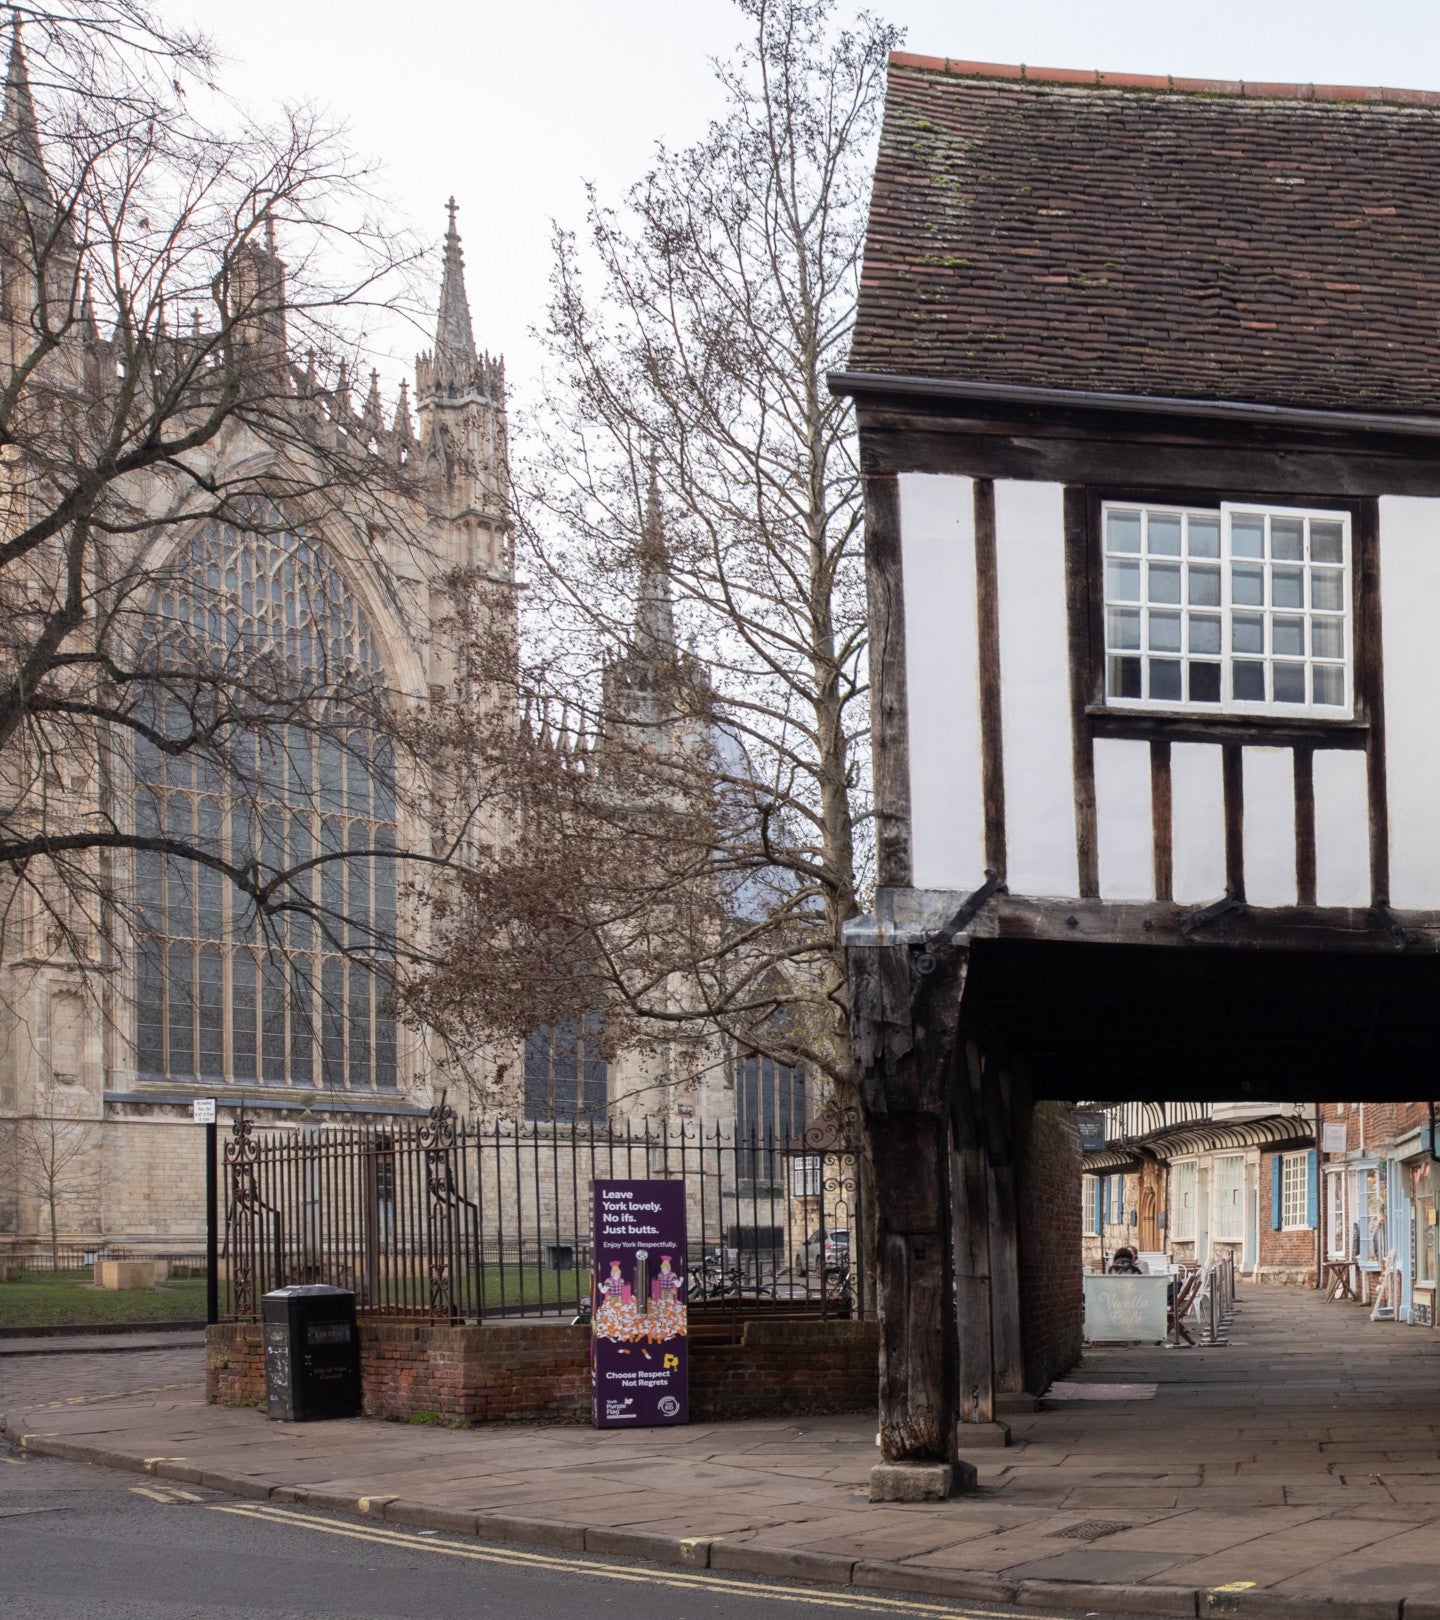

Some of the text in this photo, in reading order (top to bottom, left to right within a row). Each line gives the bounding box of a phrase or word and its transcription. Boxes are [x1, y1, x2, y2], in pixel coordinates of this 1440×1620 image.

[602, 1189, 633, 1199] Leave
[602, 1202, 662, 1212] York lovely.
[603, 1213, 637, 1222] No ifs.
[603, 1225, 659, 1234] Just butts.
[603, 1241, 621, 1249] Enjoy
[637, 1241, 677, 1249] Respectfully.
[606, 1371, 671, 1379] Choose Respect
[638, 1379, 669, 1387] Regrets
